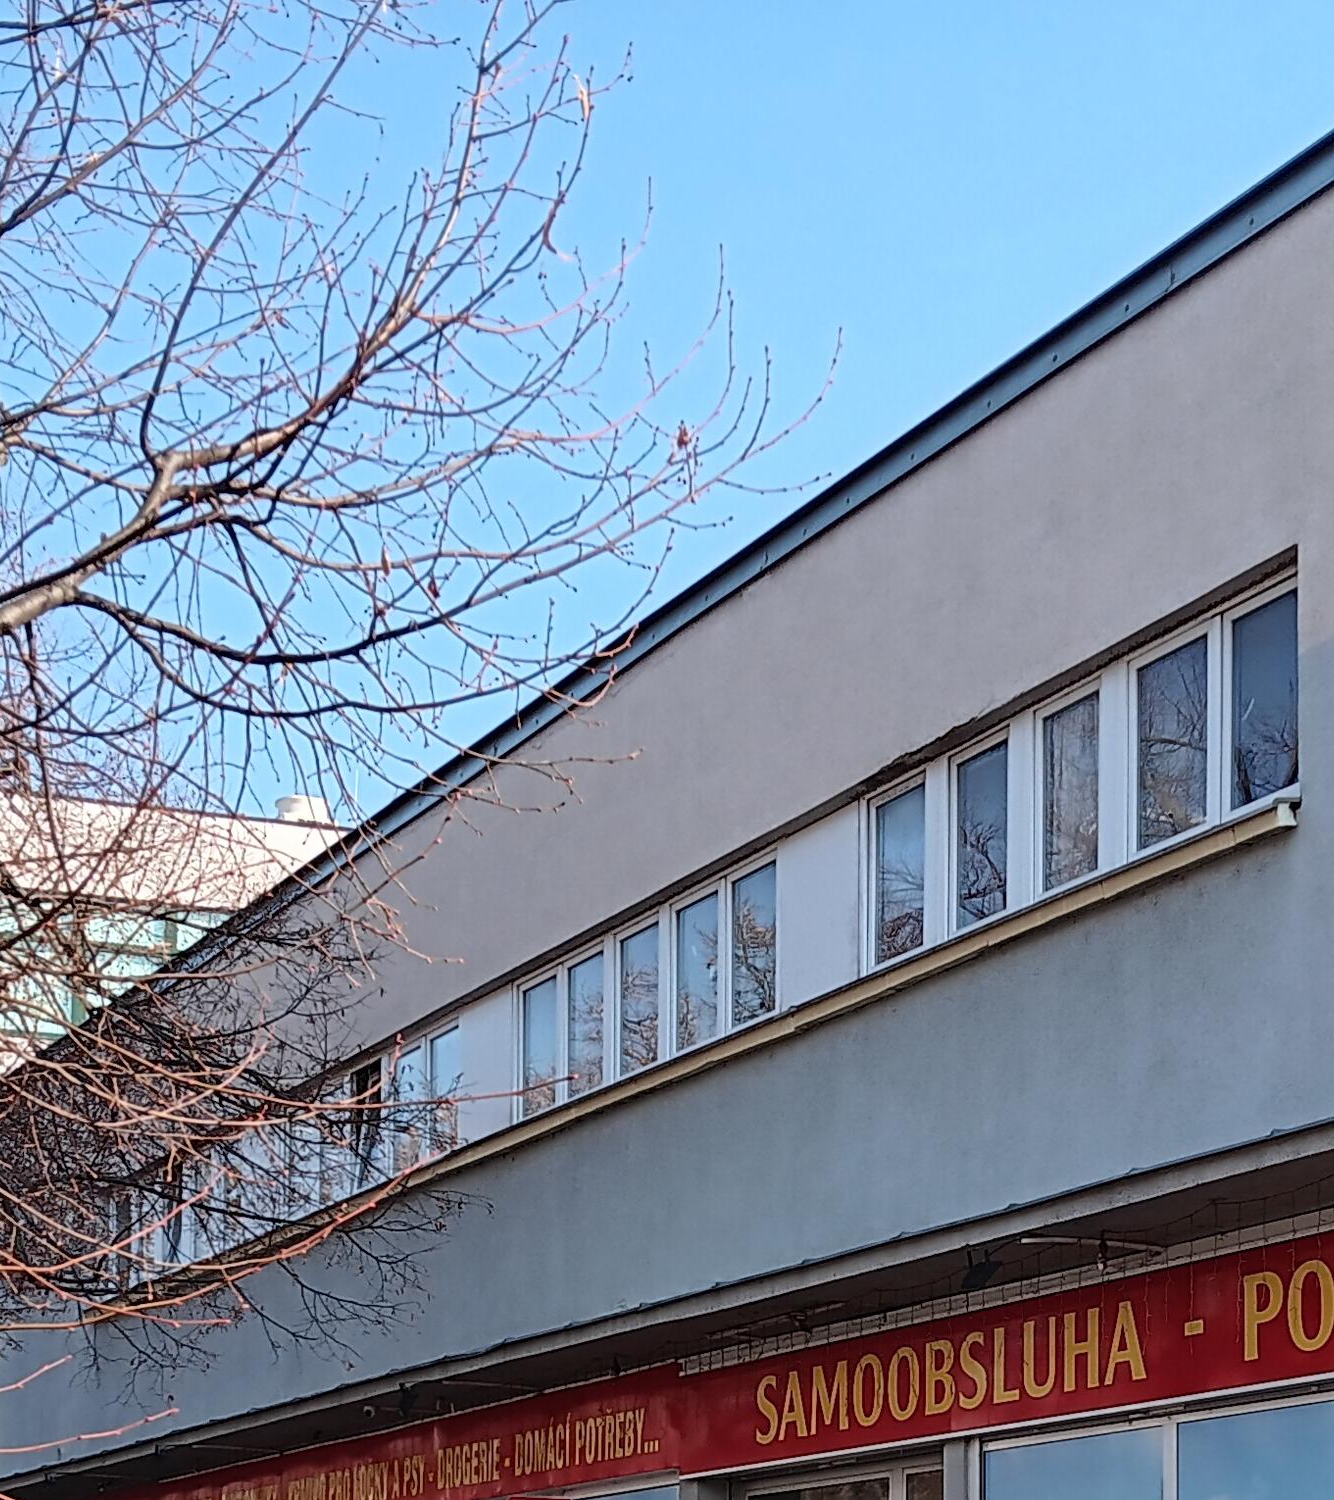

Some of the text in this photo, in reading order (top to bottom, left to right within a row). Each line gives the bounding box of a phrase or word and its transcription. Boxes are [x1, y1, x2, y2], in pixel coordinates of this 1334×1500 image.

[755, 1300, 1148, 1446] SAMOOBSLUHA
[392, 1459, 400, 1499] A
[403, 1454, 426, 1497] PSY
[436, 1437, 501, 1490] DROGERIE
[514, 1411, 572, 1477] DOMÁCÍ
